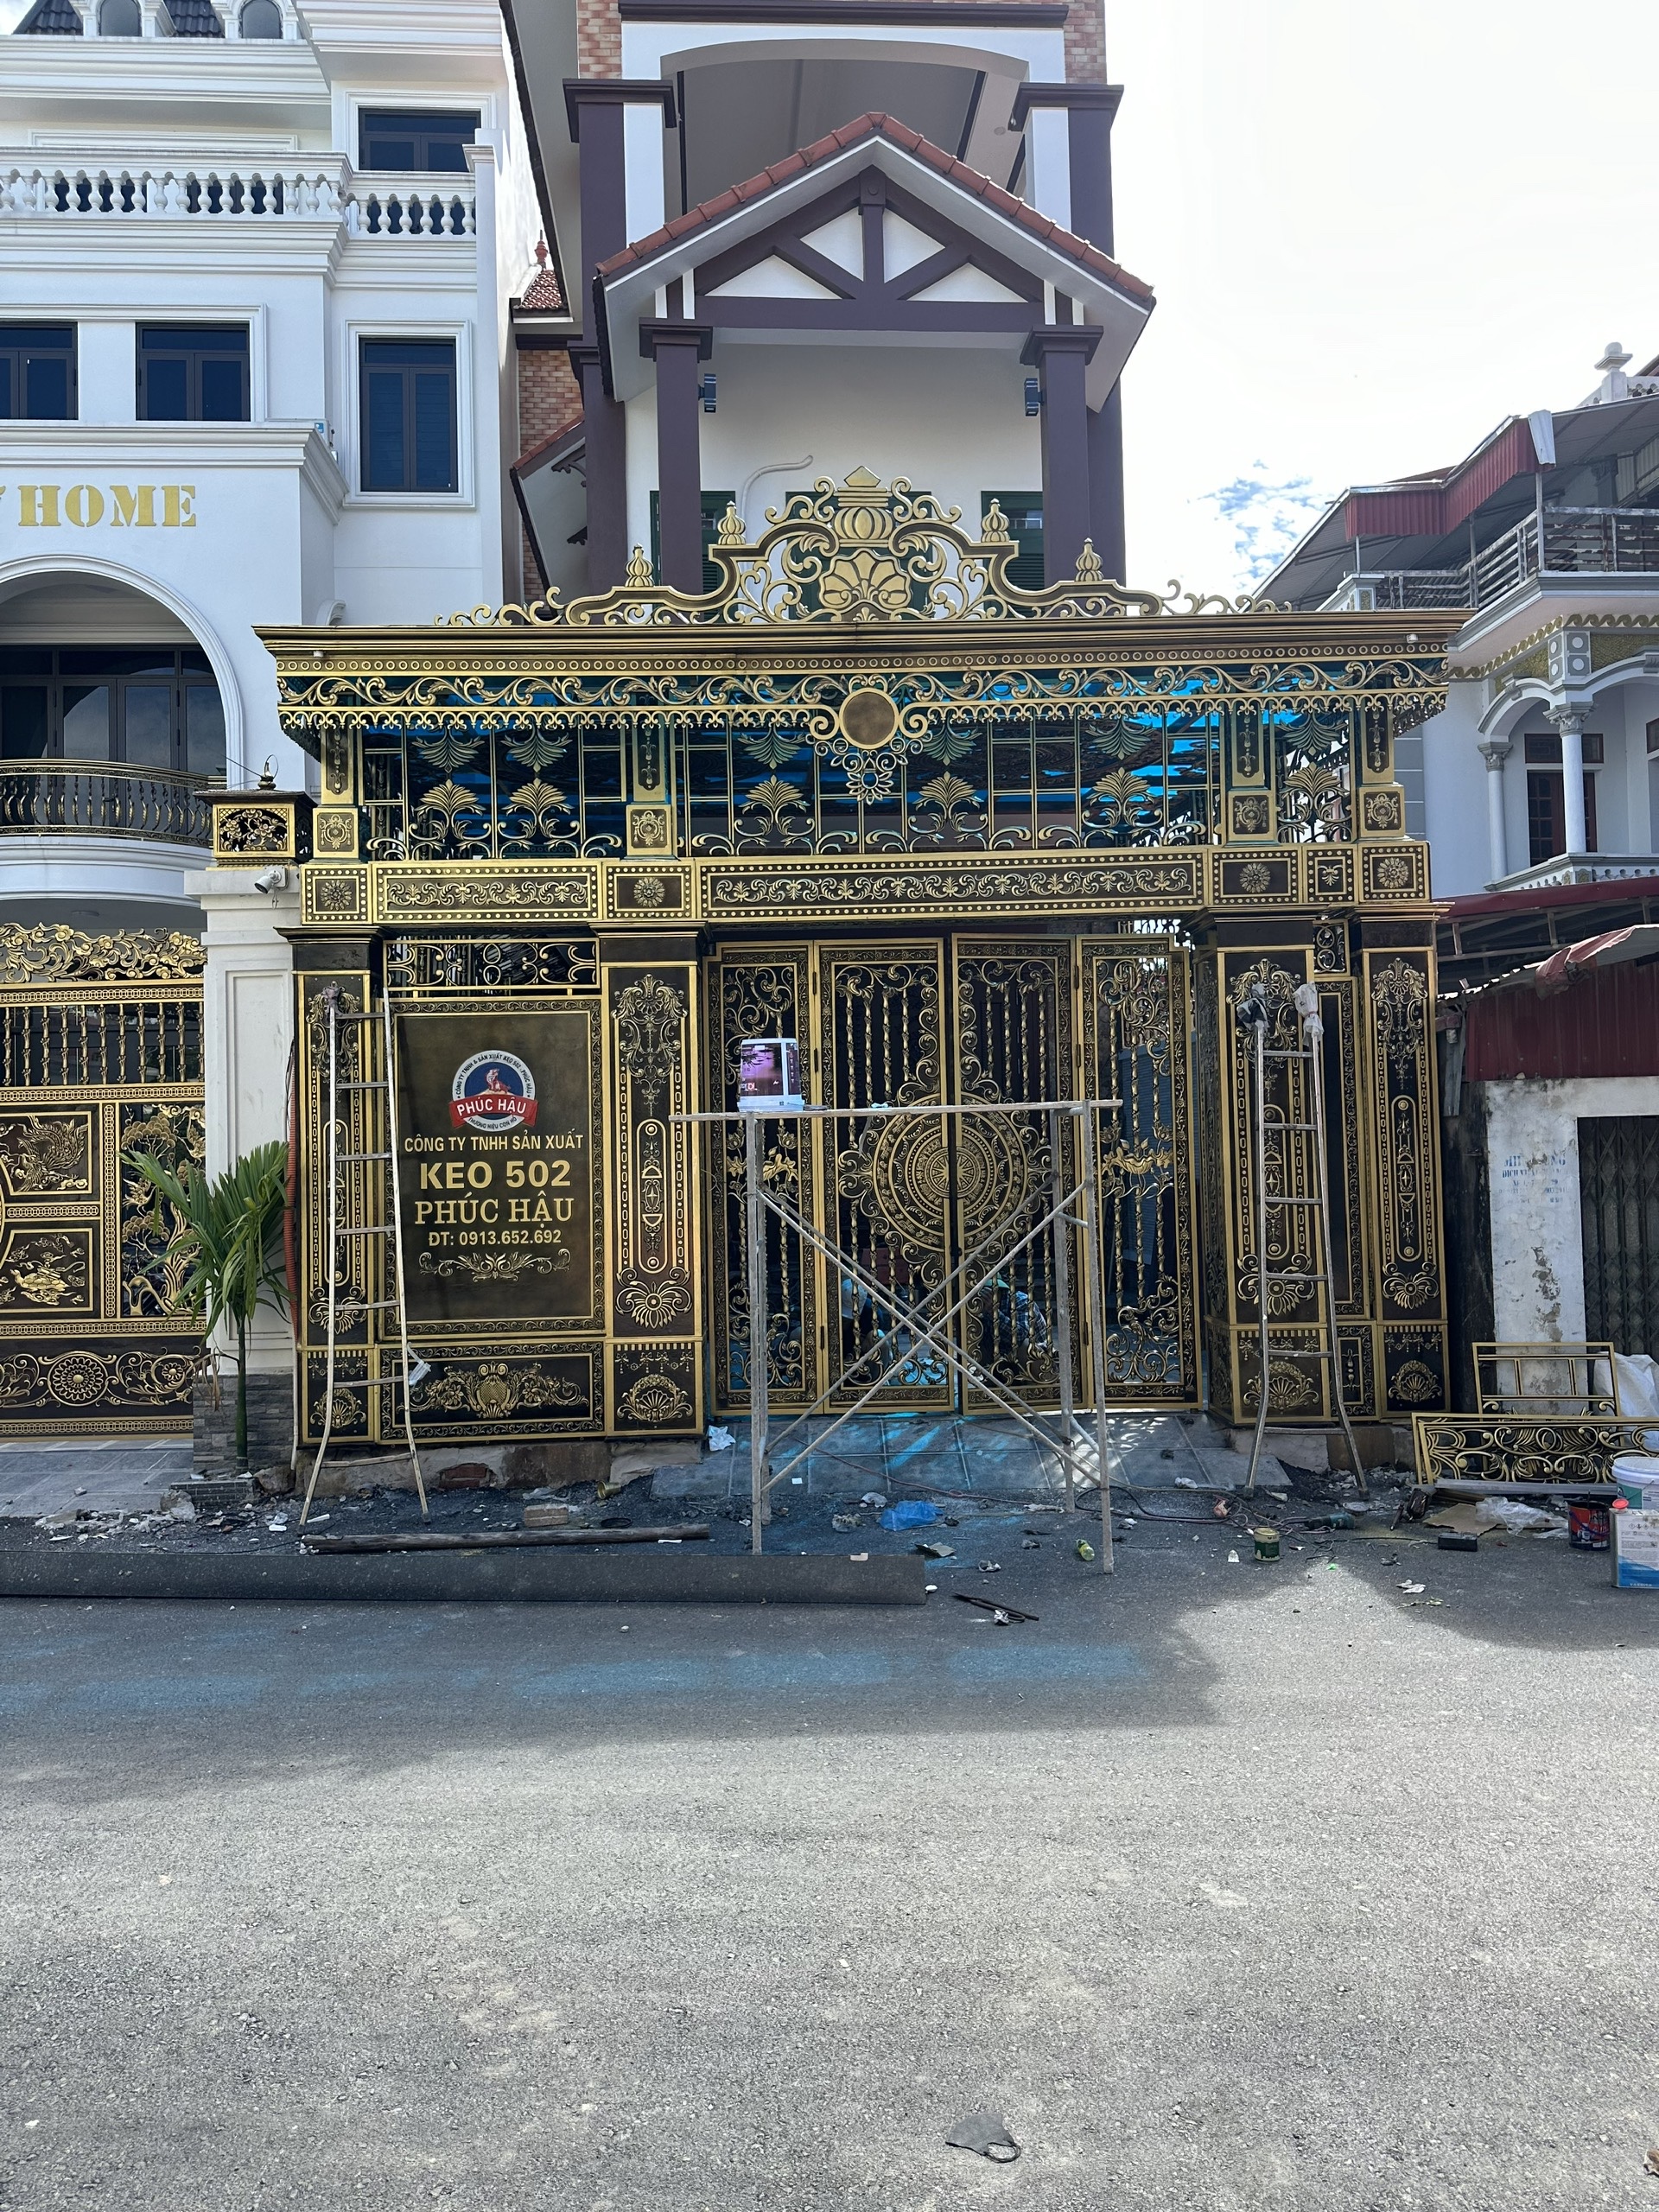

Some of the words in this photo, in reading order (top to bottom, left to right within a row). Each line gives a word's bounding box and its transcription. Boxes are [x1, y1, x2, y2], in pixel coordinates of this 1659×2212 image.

[17, 485, 197, 528] HOME
[456, 1096, 493, 1116] PHÚC
[498, 1096, 526, 1114] HẬU
[404, 1134, 444, 1153] CÔNG
[448, 1137, 467, 1151] TY
[471, 1135, 508, 1151] TNHH
[512, 1129, 541, 1150] SẢN
[545, 1128, 584, 1149] XUẤT
[420, 1161, 493, 1190] KEO
[505, 1160, 571, 1188] 502
[415, 1192, 499, 1224] PHÚC
[508, 1190, 575, 1229] HẬU
[429, 1231, 454, 1247] ĐT:
[459, 1230, 562, 1246] 0913.652.692
